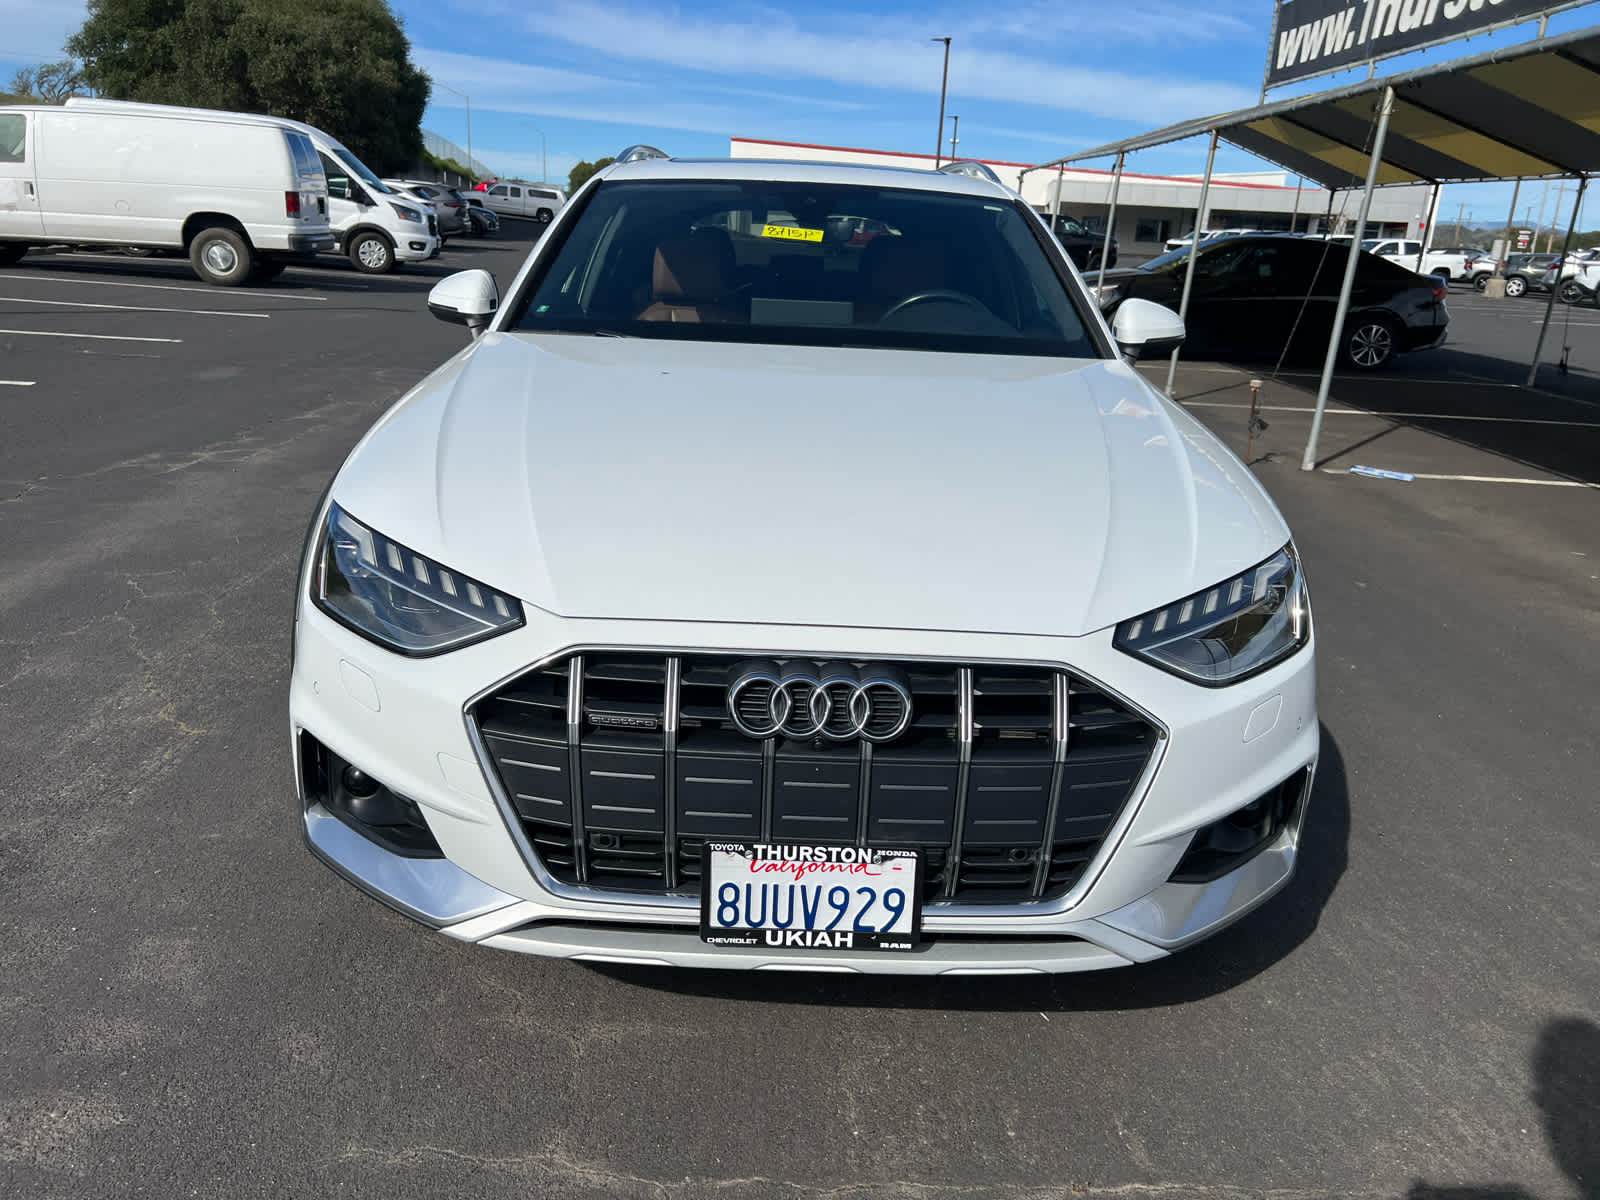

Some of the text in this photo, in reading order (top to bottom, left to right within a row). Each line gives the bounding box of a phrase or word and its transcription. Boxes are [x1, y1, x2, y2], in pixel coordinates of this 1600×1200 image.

[1276, 0, 1502, 70] www.Thur
[753, 844, 873, 865] THURSTON
[750, 859, 882, 880] California
[717, 882, 906, 932] 8UUV929
[707, 937, 758, 945] CHEVROLET
[765, 930, 853, 947] UKIAH
